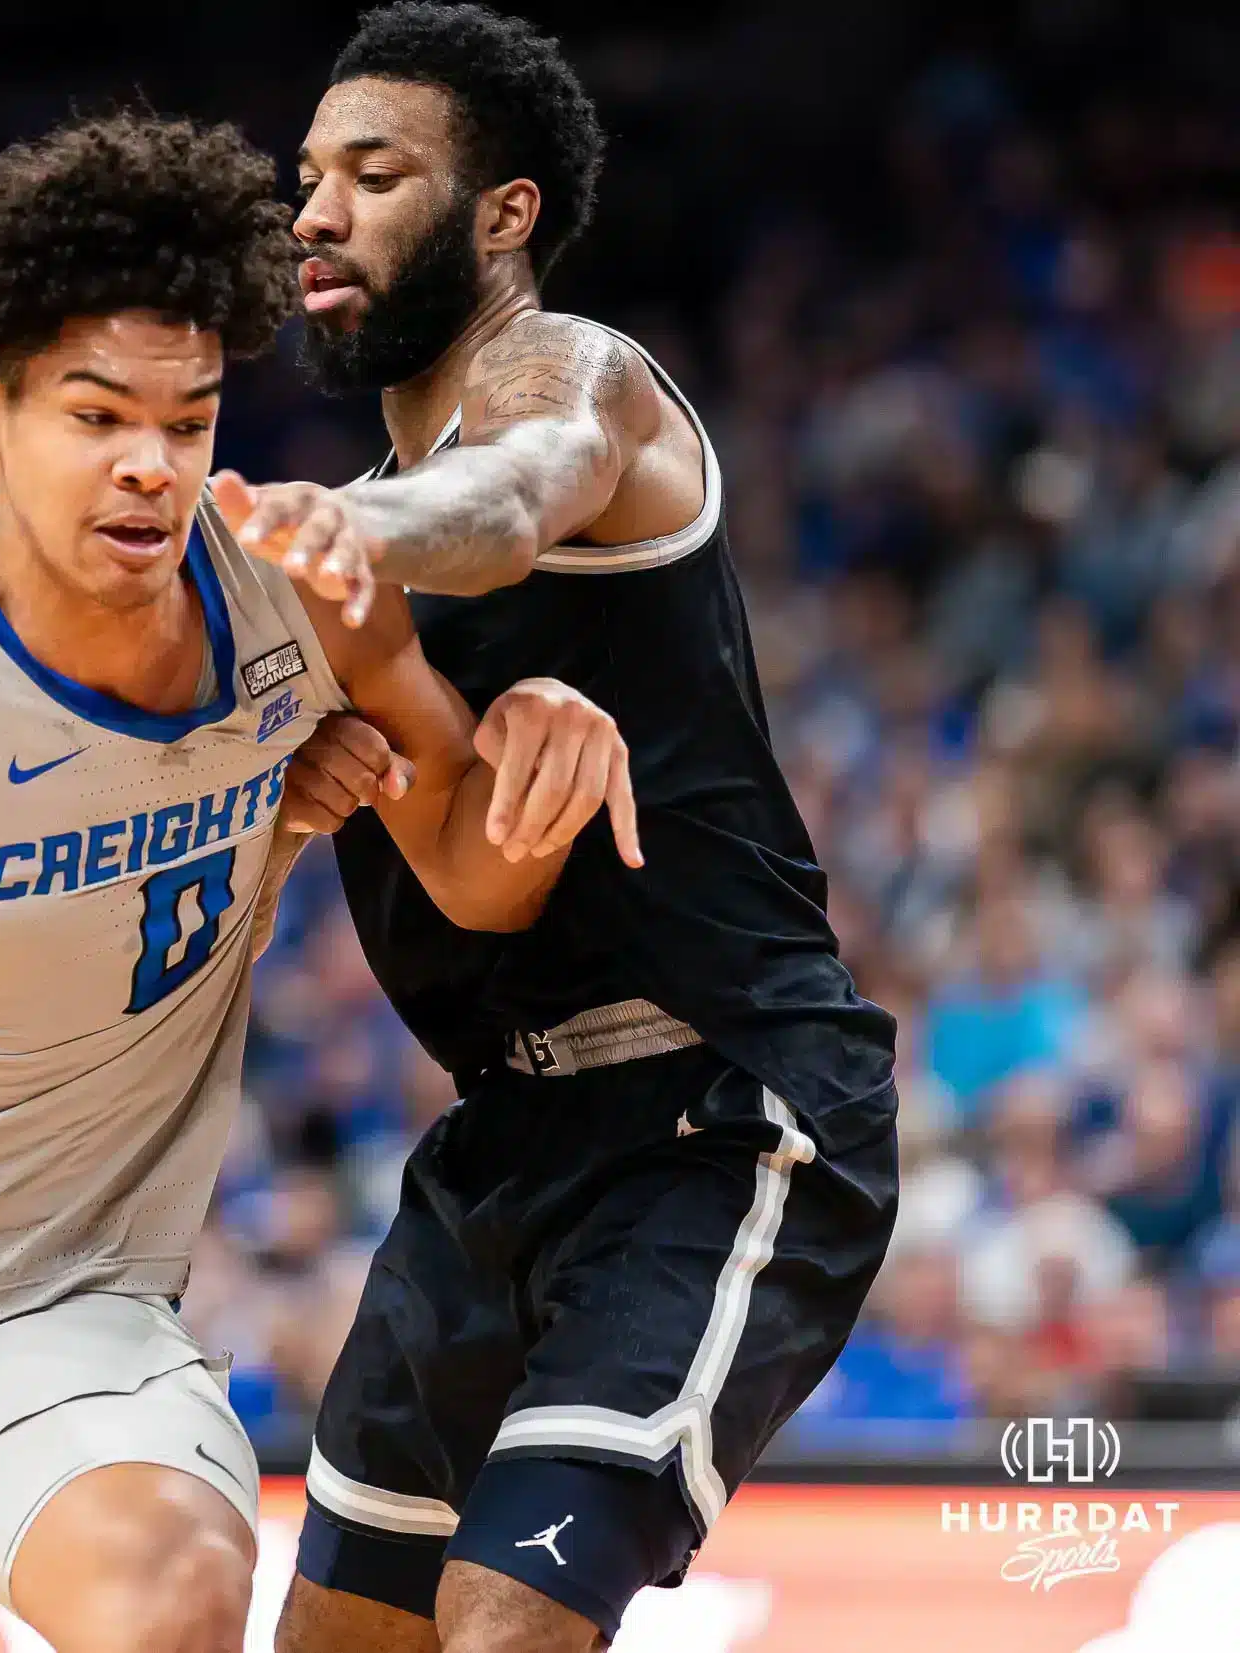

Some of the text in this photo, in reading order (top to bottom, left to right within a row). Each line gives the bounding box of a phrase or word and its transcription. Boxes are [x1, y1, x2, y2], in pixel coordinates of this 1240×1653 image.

[250, 659, 303, 695] CHANGE
[256, 699, 303, 738] EAST
[261, 690, 293, 721] BIG
[122, 846, 236, 1015] 0
